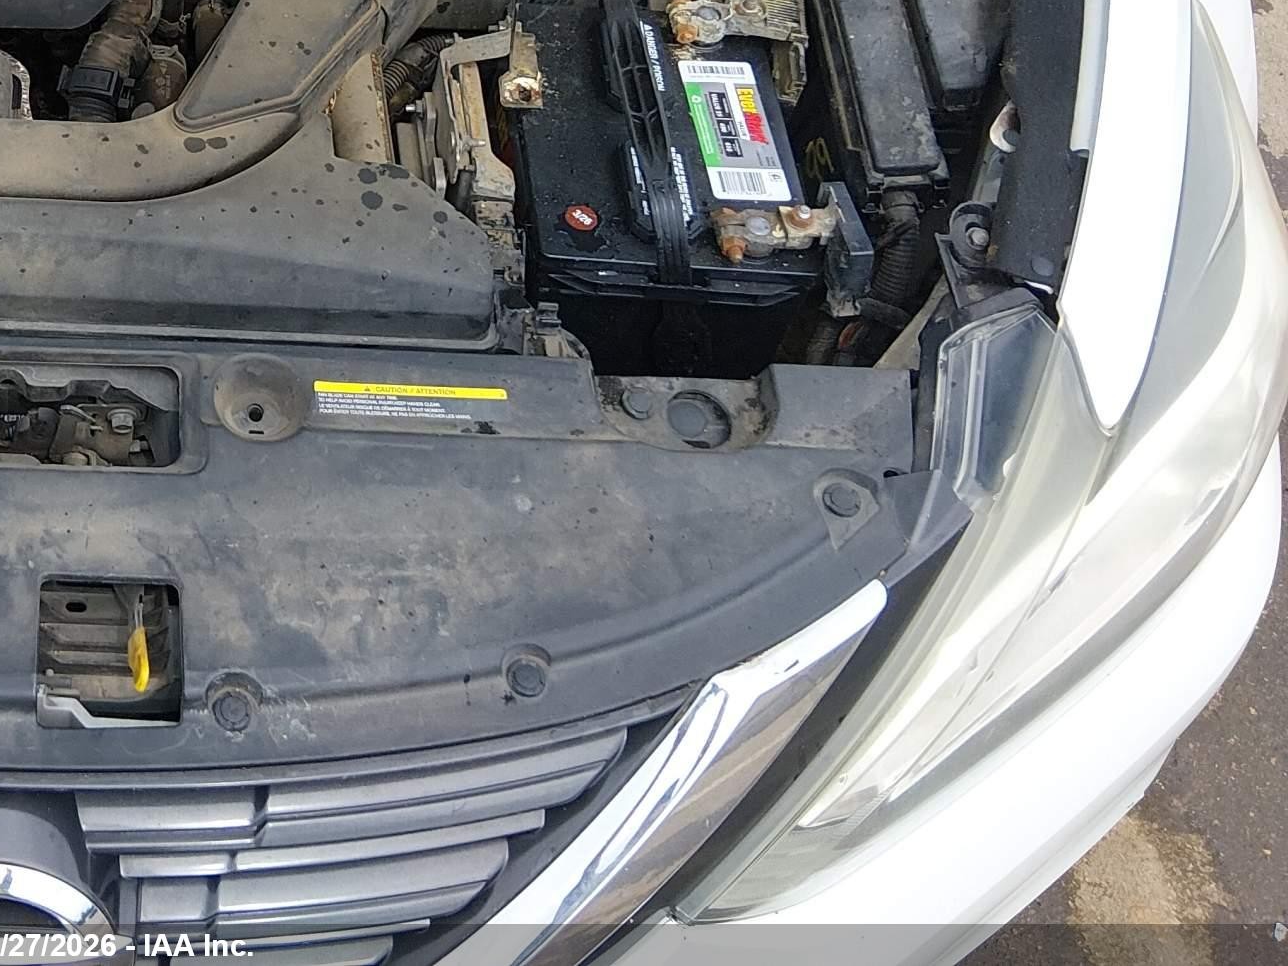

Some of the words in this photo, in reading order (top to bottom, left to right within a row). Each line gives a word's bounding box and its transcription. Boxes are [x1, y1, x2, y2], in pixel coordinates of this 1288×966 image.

[644, 31, 659, 59] DANGER
[652, 65, 665, 92] POISON
[572, 209, 593, 225] 3/26
[375, 386, 408, 394] CAUTION
[415, 388, 456, 396] ATTENTION
